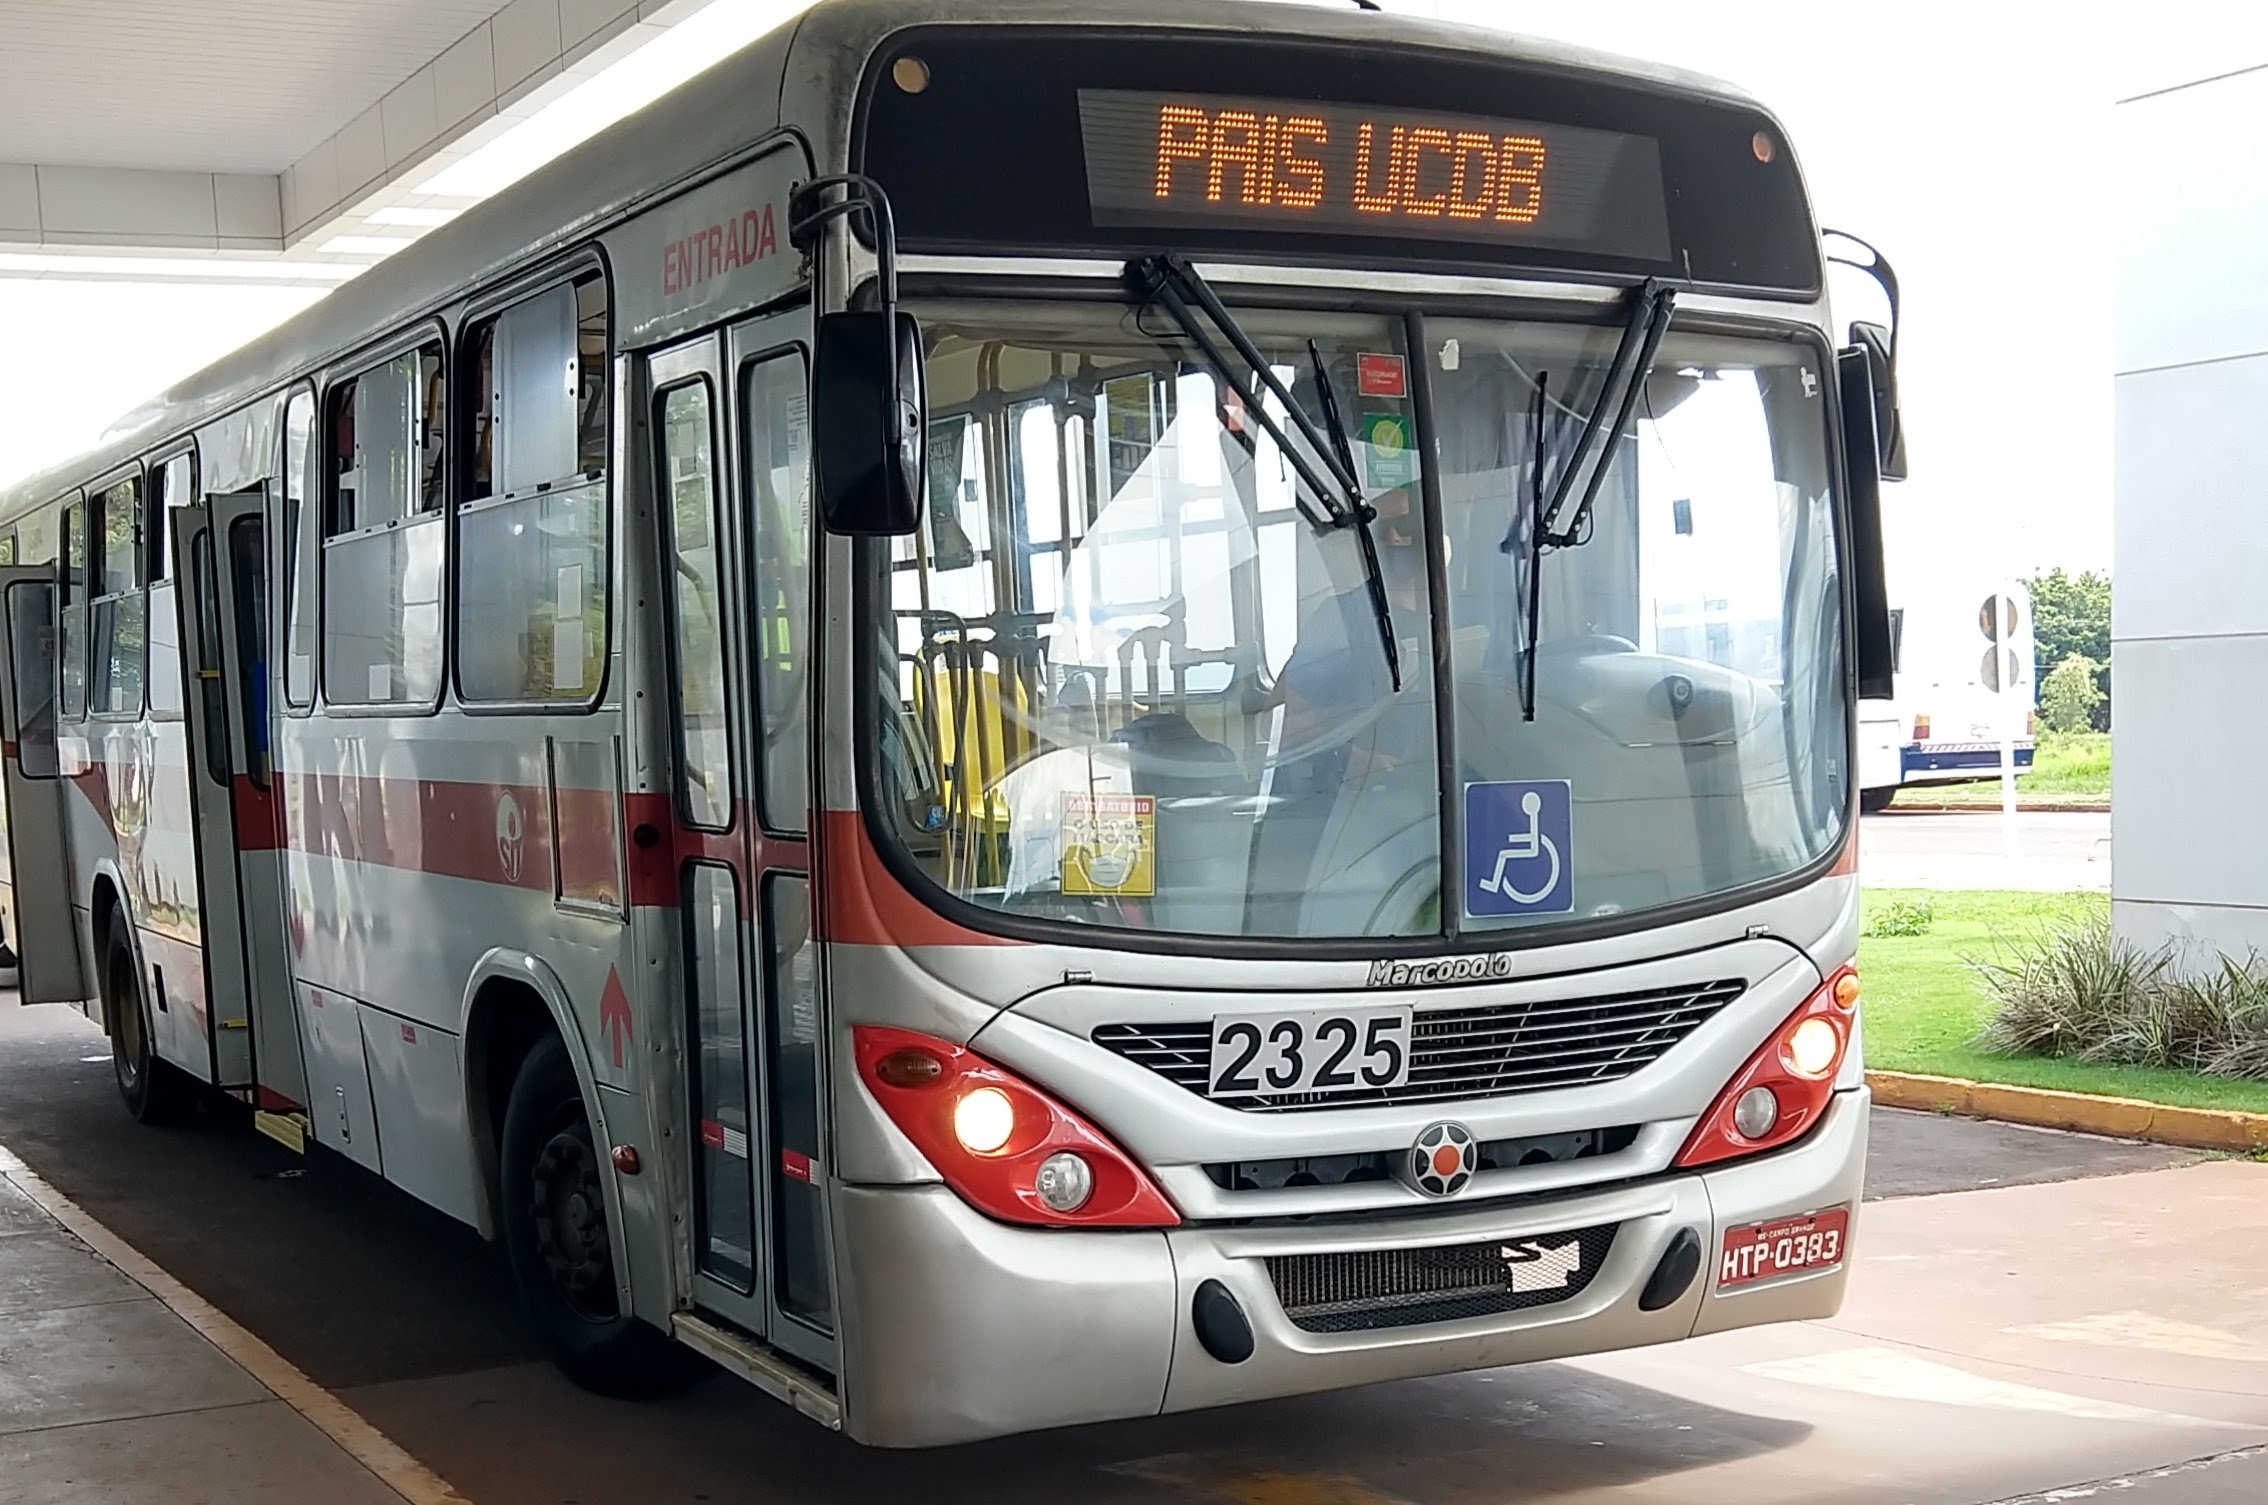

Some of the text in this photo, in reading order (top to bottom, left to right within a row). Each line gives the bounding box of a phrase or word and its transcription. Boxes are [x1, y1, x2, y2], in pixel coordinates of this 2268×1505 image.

[1156, 104, 1546, 223] PAIS UCDB
[663, 202, 777, 296] ENTRADA
[1366, 952, 1512, 986] Marcopolo
[1212, 1016, 1403, 1093] 2325
